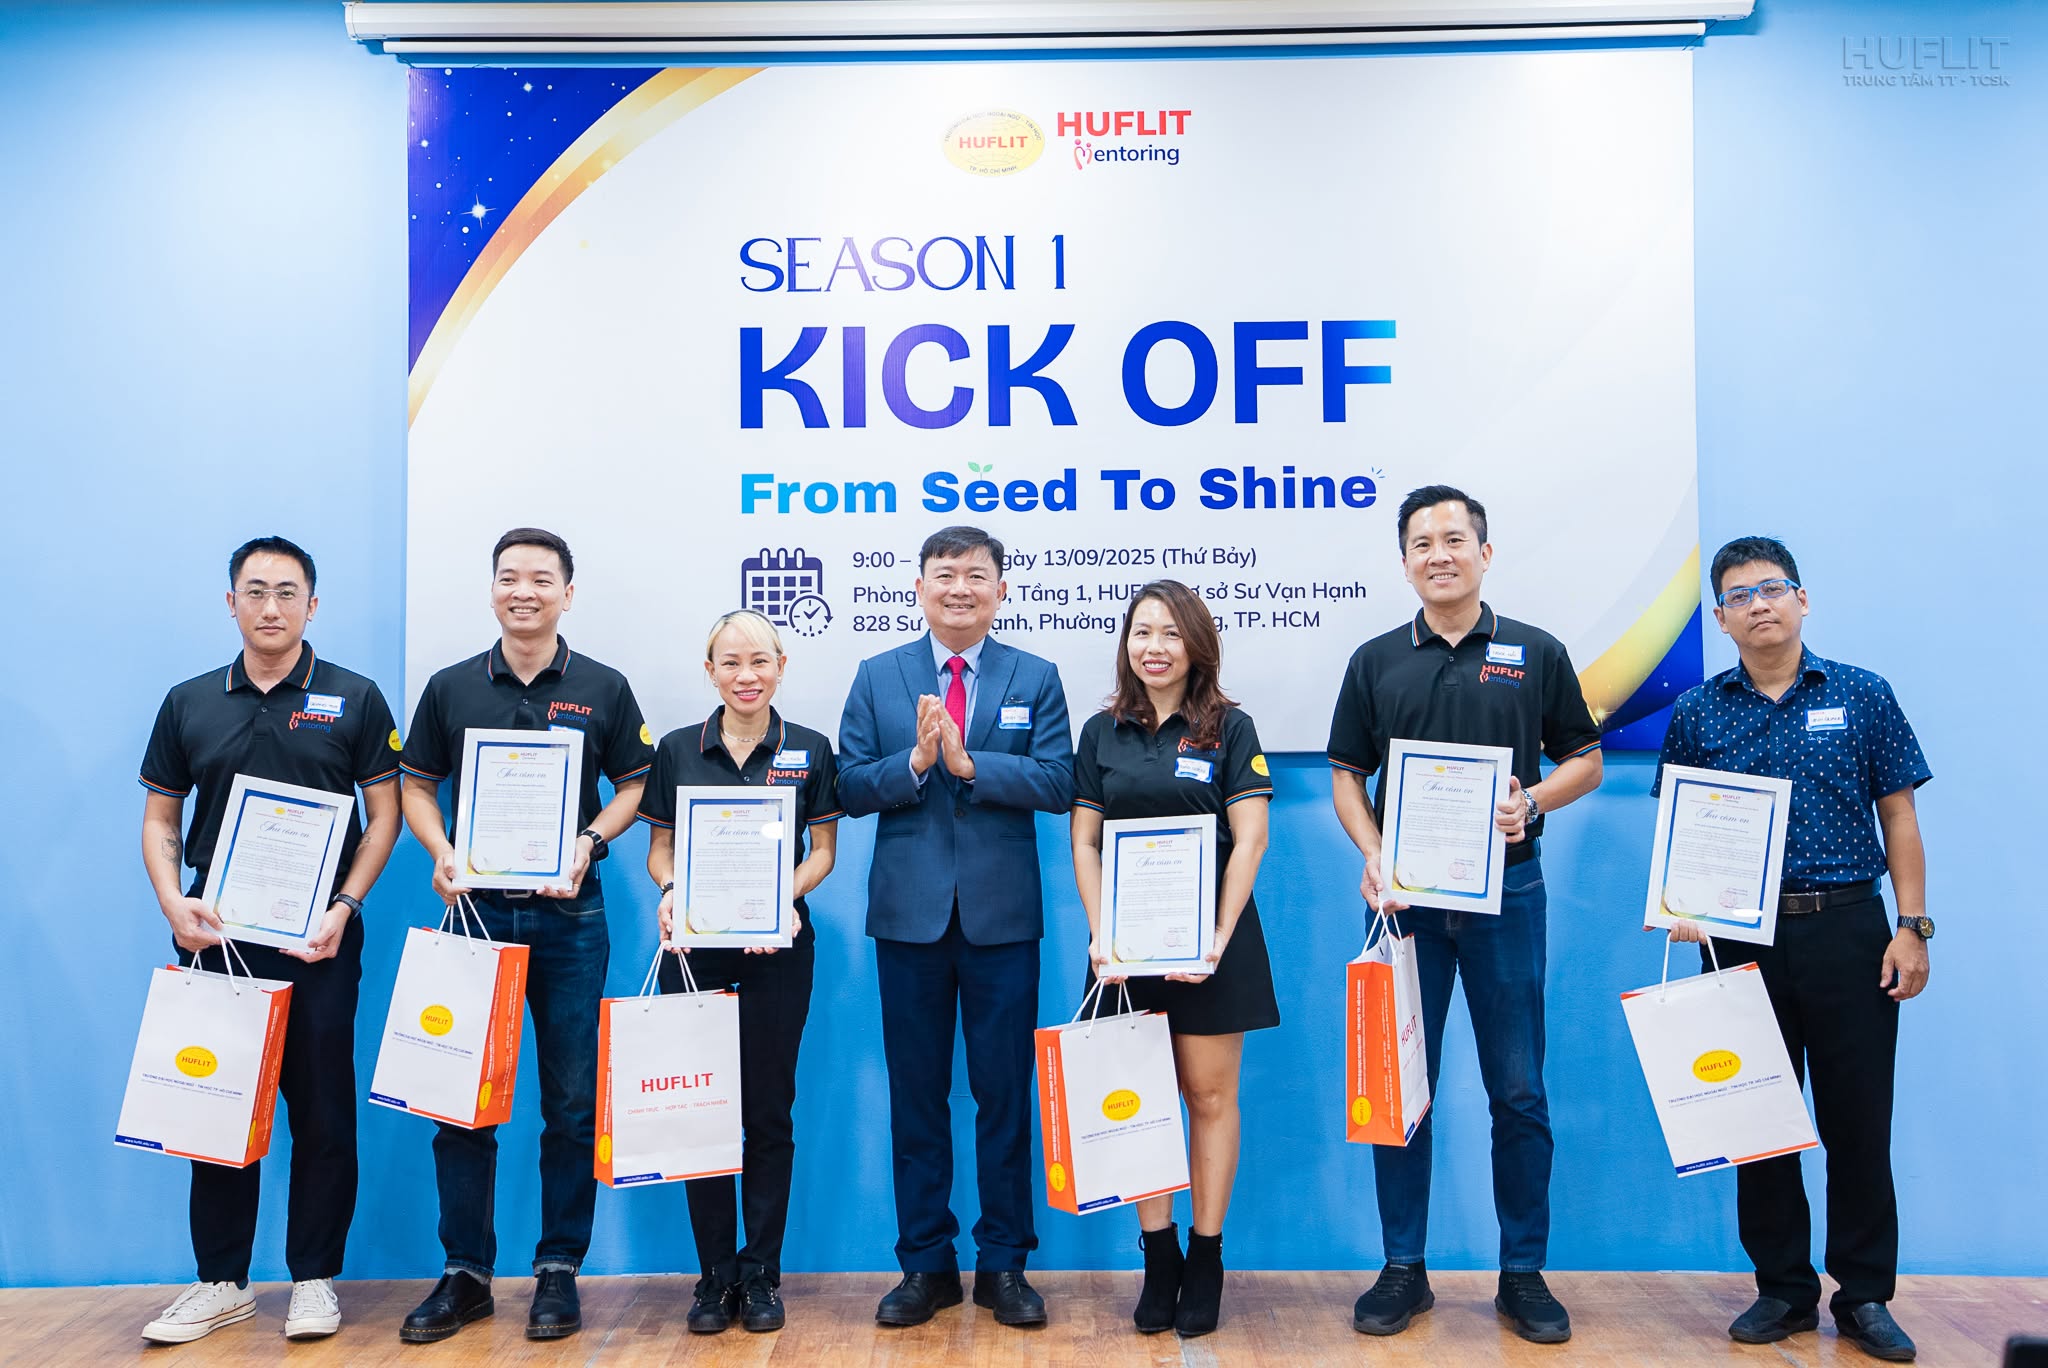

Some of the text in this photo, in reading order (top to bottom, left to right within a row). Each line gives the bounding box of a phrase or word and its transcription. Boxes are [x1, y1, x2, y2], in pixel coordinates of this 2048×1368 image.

[1057, 110, 1192, 137] HUFLIT
[959, 135, 1029, 149] HUFLIT
[739, 234, 1067, 293] SEASON 1
[739, 319, 1398, 430] KICK OFF
[740, 464, 1377, 515] From Seed To Shine
[852, 551, 895, 569] 9:00
[1002, 545, 1257, 572] gày 13/09/2025 (Thứ Bảy)
[853, 584, 916, 607] Phòng
[1016, 582, 1069, 606] Tầng
[1076, 584, 1093, 604] 1,
[1205, 581, 1229, 600] sở
[1233, 582, 1262, 600] Sư
[1264, 582, 1307, 604] Vạn
[1312, 580, 1367, 603] Hạnh
[852, 614, 924, 632] 828 Sư
[991, 612, 1033, 635] ạnh,
[1039, 611, 1116, 635] Phường
[1233, 611, 1266, 628] TP.
[1272, 610, 1320, 628] HCM
[1481, 664, 1526, 680] HUFLIT
[549, 700, 593, 716] HUFLIT
[767, 768, 809, 780] HUFLIT
[181, 1056, 212, 1068] HUFLIT
[1699, 1059, 1733, 1073] HUFLIT
[641, 1072, 714, 1093] HUFLIT
[1108, 1099, 1135, 1111] HUFLIT
